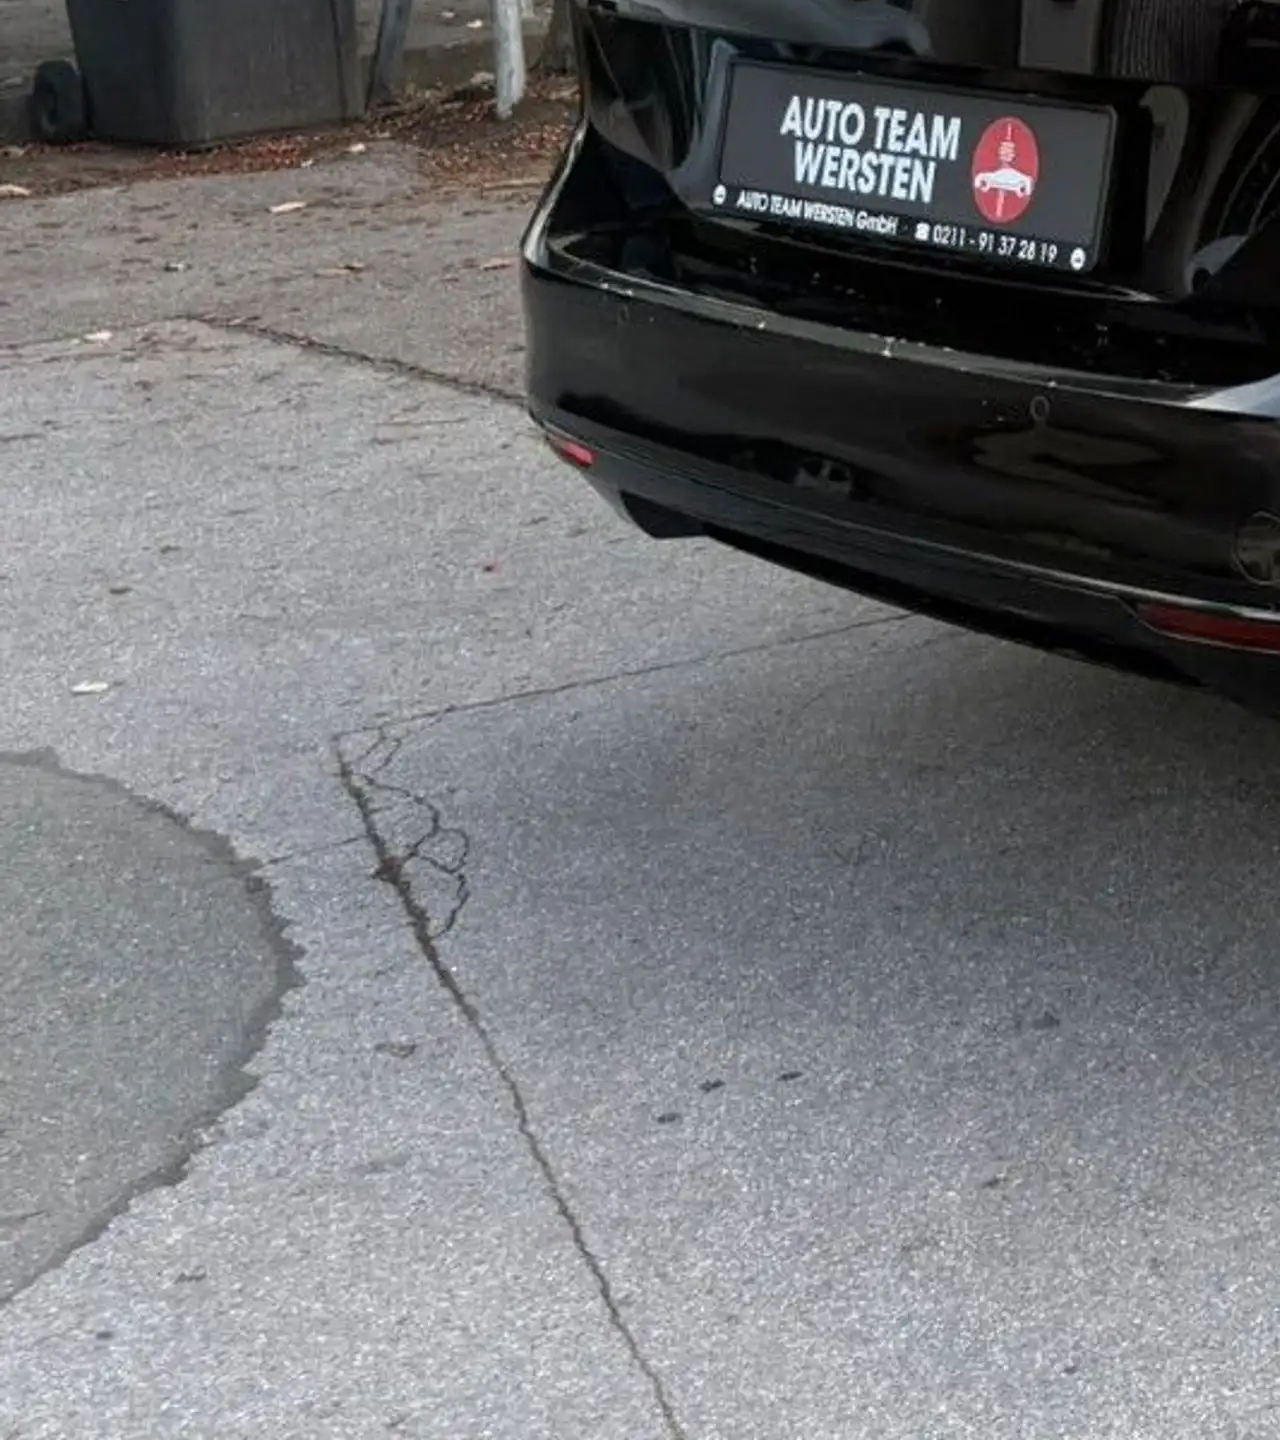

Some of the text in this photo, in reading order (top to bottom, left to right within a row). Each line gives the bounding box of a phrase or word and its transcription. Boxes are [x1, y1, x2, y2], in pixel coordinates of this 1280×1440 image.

[780, 95, 961, 161] AUTO TEAM
[795, 139, 936, 204] WERSTEN
[736, 189, 769, 211] AUTO
[769, 193, 803, 219] TEAM
[803, 200, 856, 227] WERSTEN
[855, 210, 900, 235] GmbH
[933, 225, 966, 248] 0211
[978, 231, 995, 253] 91
[999, 235, 1017, 257] 37
[1040, 243, 1058, 264] 19
